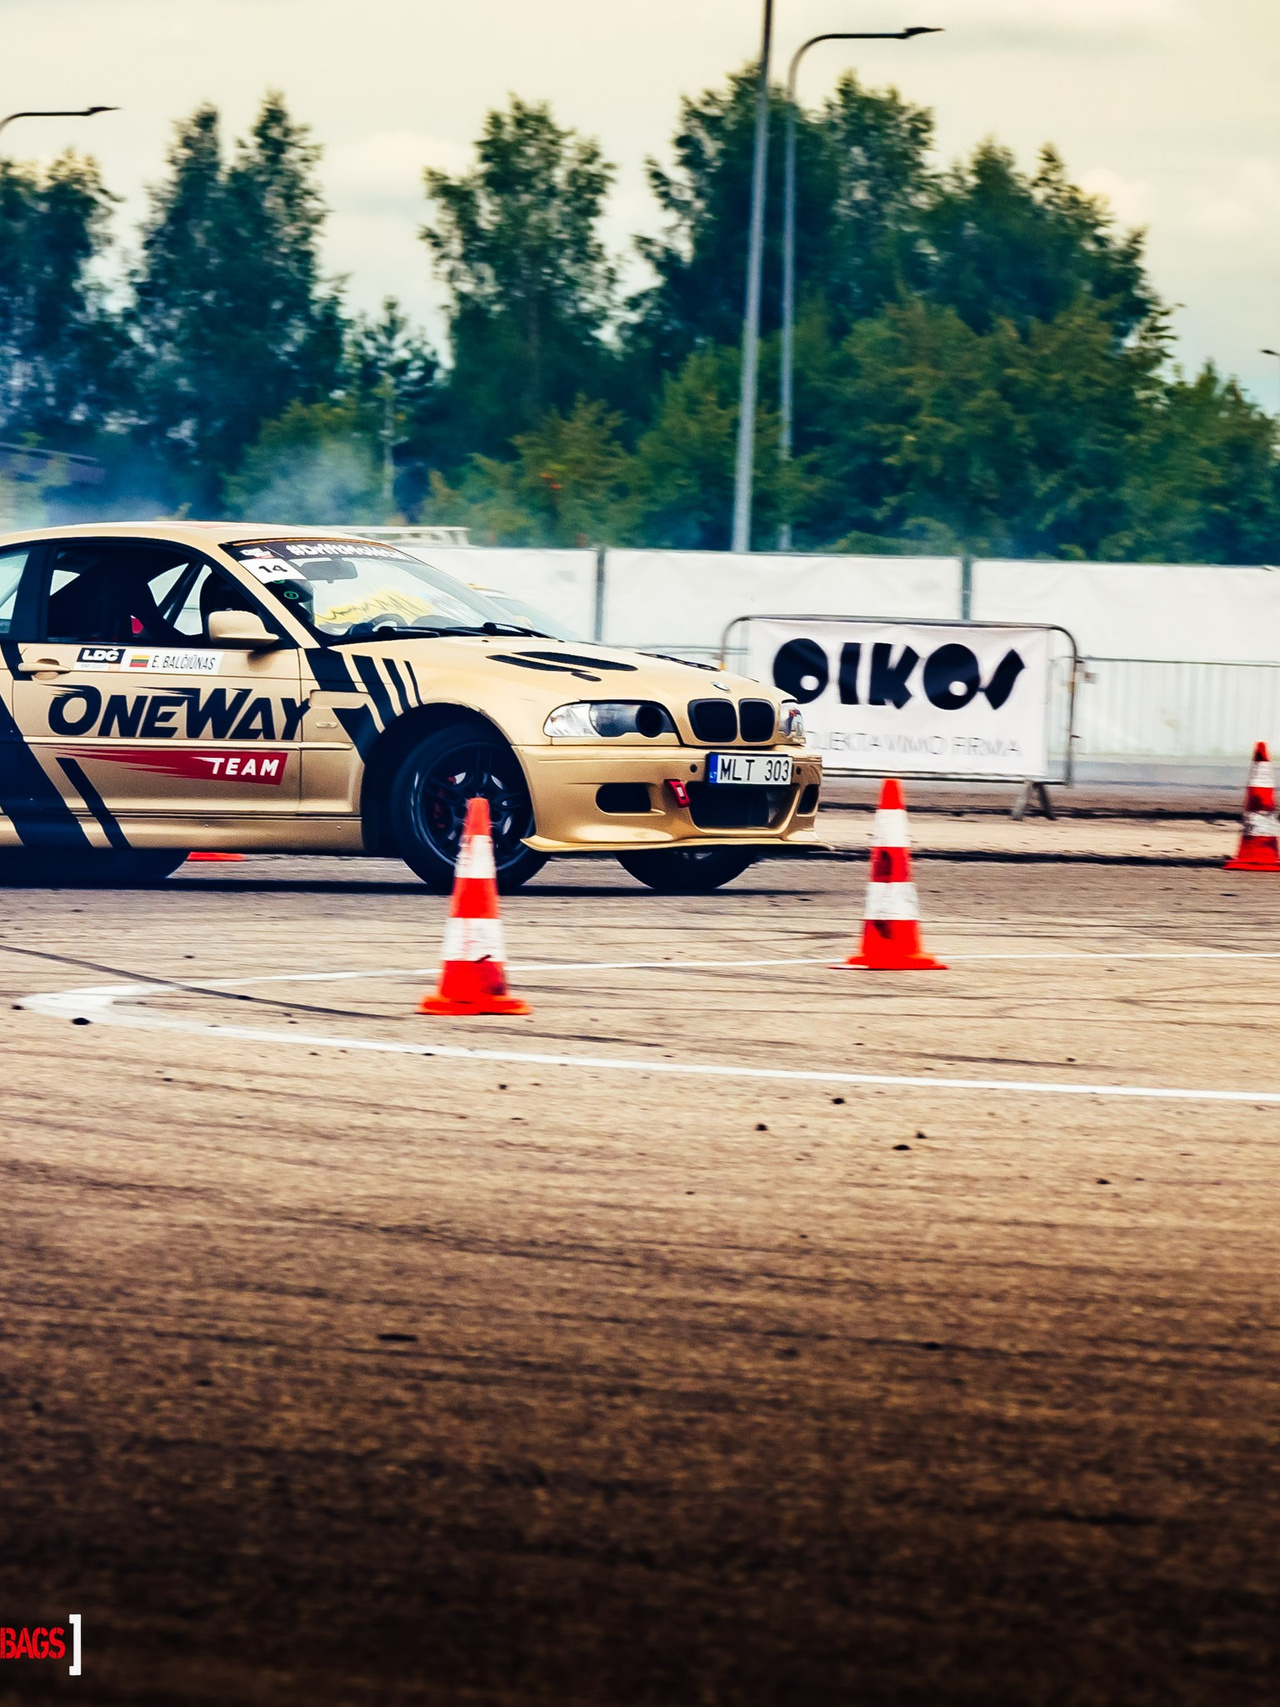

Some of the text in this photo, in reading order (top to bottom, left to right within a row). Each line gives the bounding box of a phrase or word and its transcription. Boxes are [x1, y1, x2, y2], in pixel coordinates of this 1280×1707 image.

[259, 564, 288, 574] 14
[82, 648, 120, 662] LDČ
[151, 654, 216, 670] E. BALČIŪNAS
[773, 638, 1026, 710] OIKOS
[42, 684, 312, 741] ONEWAY
[199, 757, 280, 777] TEAM
[720, 758, 790, 782] MLT 303
